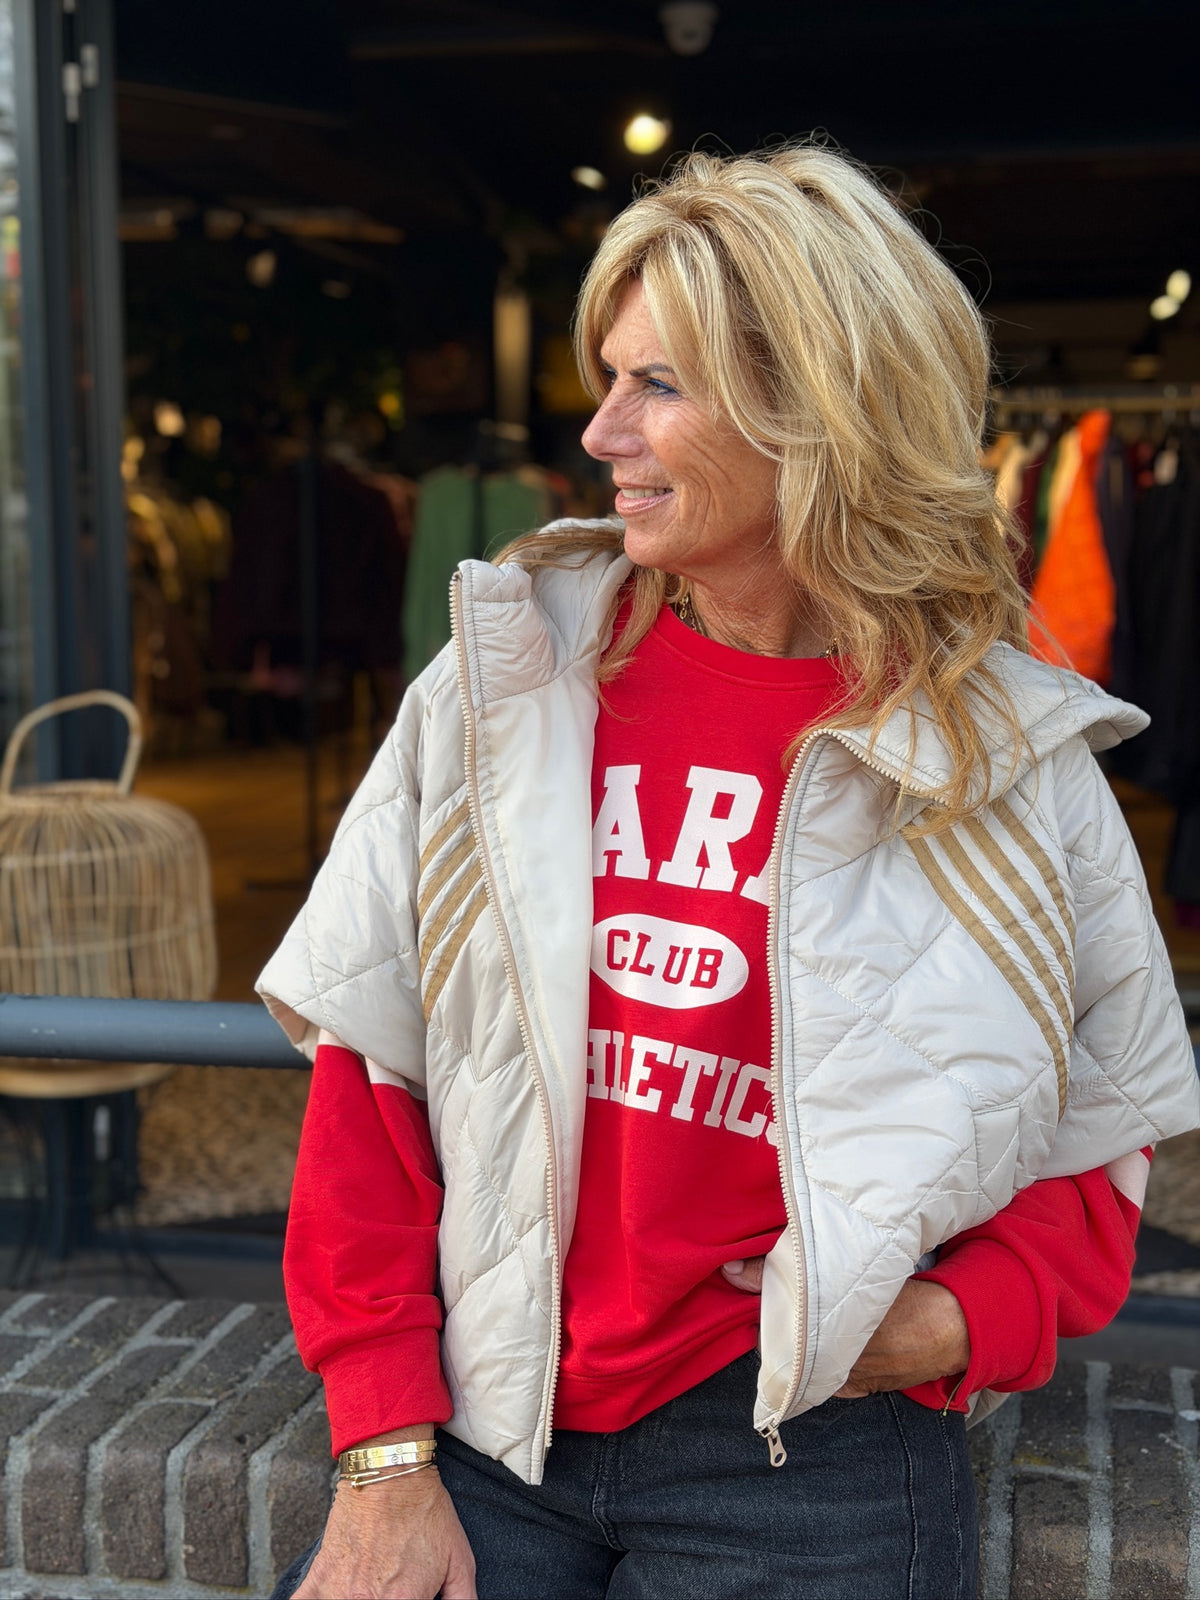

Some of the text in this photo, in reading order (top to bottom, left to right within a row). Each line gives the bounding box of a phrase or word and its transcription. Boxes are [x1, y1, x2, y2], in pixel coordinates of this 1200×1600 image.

[592, 764, 771, 906] AR
[606, 928, 723, 989] CLUB
[586, 1028, 778, 1147] HLETIC
